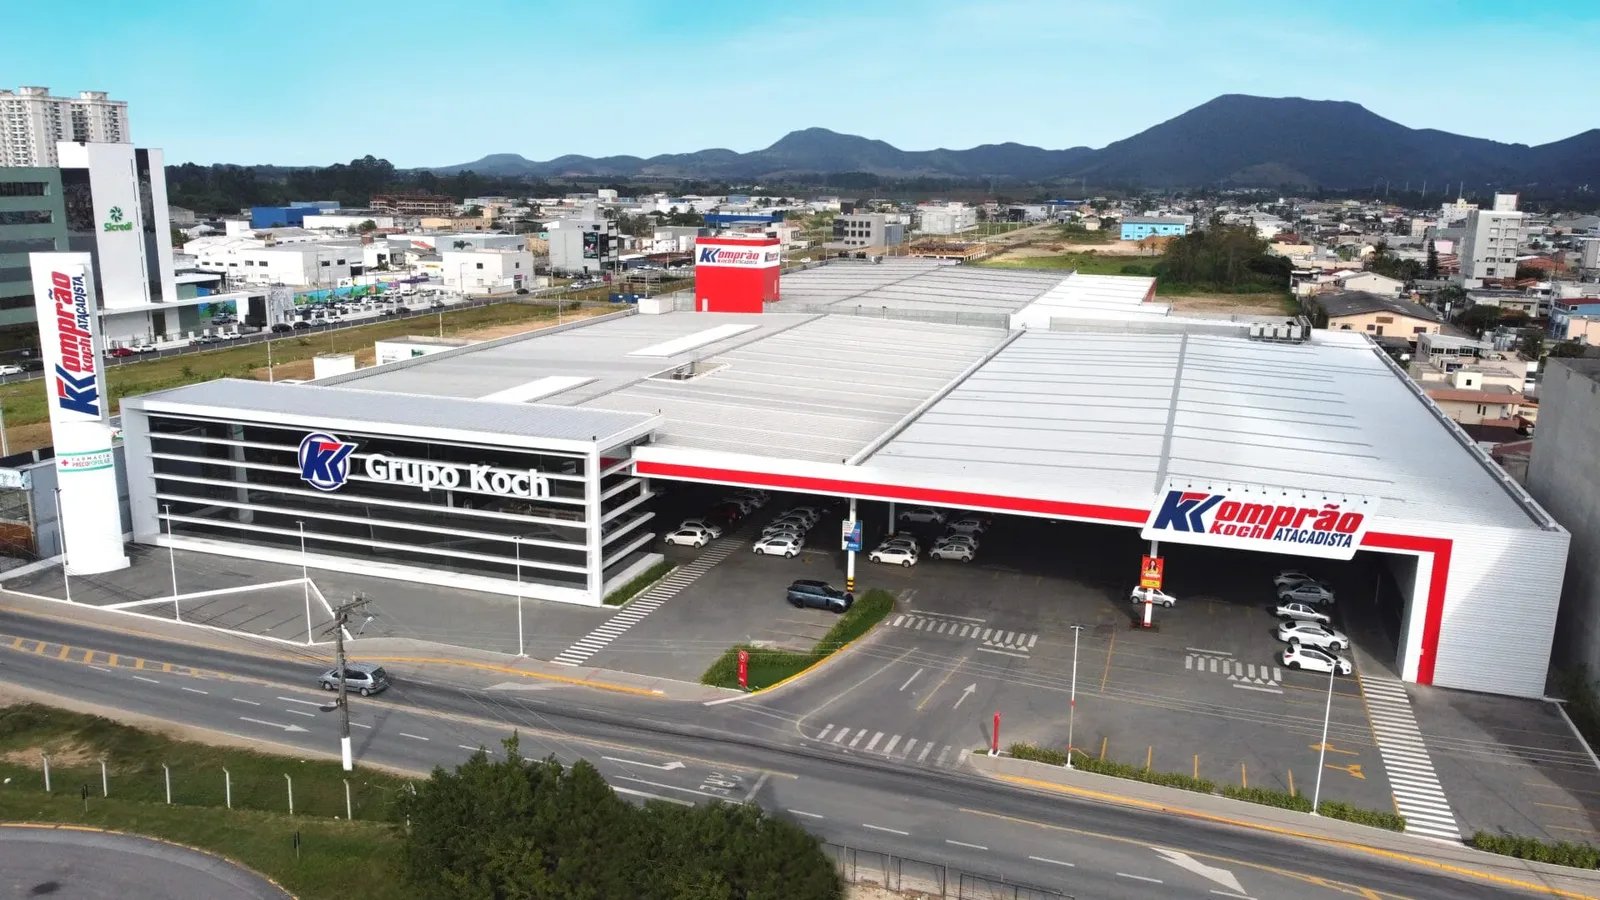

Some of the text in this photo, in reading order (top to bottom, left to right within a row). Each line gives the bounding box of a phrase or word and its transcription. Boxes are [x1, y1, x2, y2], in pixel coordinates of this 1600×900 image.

[104, 222, 133, 232] Sicredi
[72, 276, 94, 373] koch ATACADISTA
[365, 454, 550, 499] Grupo Koch
[1209, 521, 1353, 548] koch ATACADISTA
